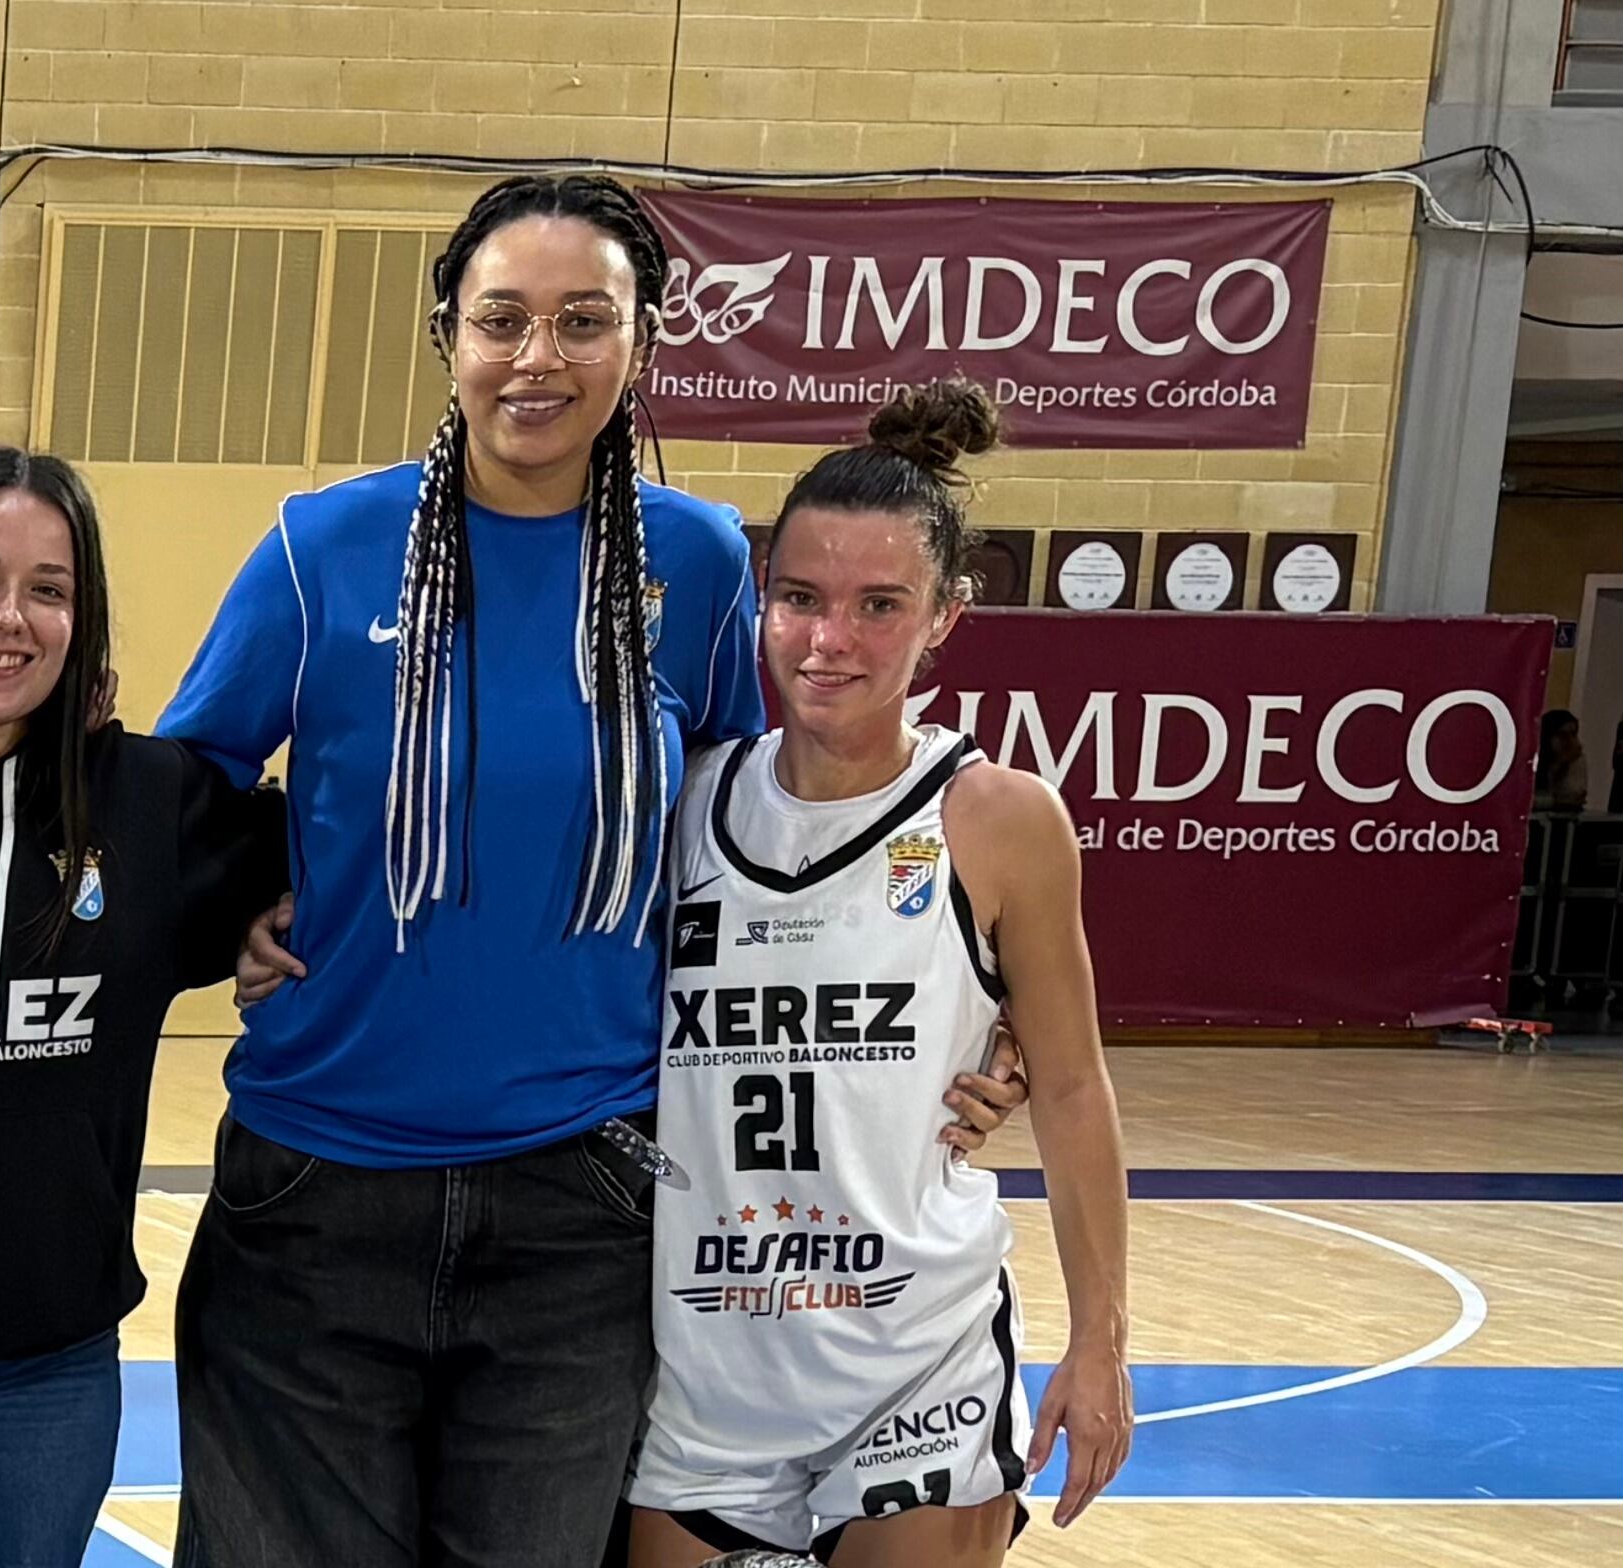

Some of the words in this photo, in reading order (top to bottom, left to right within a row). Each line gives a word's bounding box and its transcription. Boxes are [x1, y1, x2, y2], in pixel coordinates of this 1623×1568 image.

[802, 255, 1291, 356] IMDECO
[651, 368, 778, 401] Instituto
[785, 374, 937, 404] Municip
[995, 376, 1138, 413] Deportes
[1146, 379, 1277, 408] Córdoba
[956, 688, 1517, 803] IMDECO
[1117, 818, 1164, 851] de
[1176, 820, 1336, 859] Deportes
[1351, 820, 1501, 853] Córdoba
[668, 982, 916, 1049] XEREZ
[667, 1051, 701, 1068] CLUB
[703, 1050, 785, 1067] DEPORTIVO
[788, 1046, 916, 1063] BALONCESTO
[732, 1071, 820, 1172] 21
[693, 1232, 884, 1274] DESAFIO
[786, 1277, 863, 1311] CLUB
[857, 1395, 987, 1450] ENCIO
[854, 1436, 959, 1469] AUTOMOCIÓN
